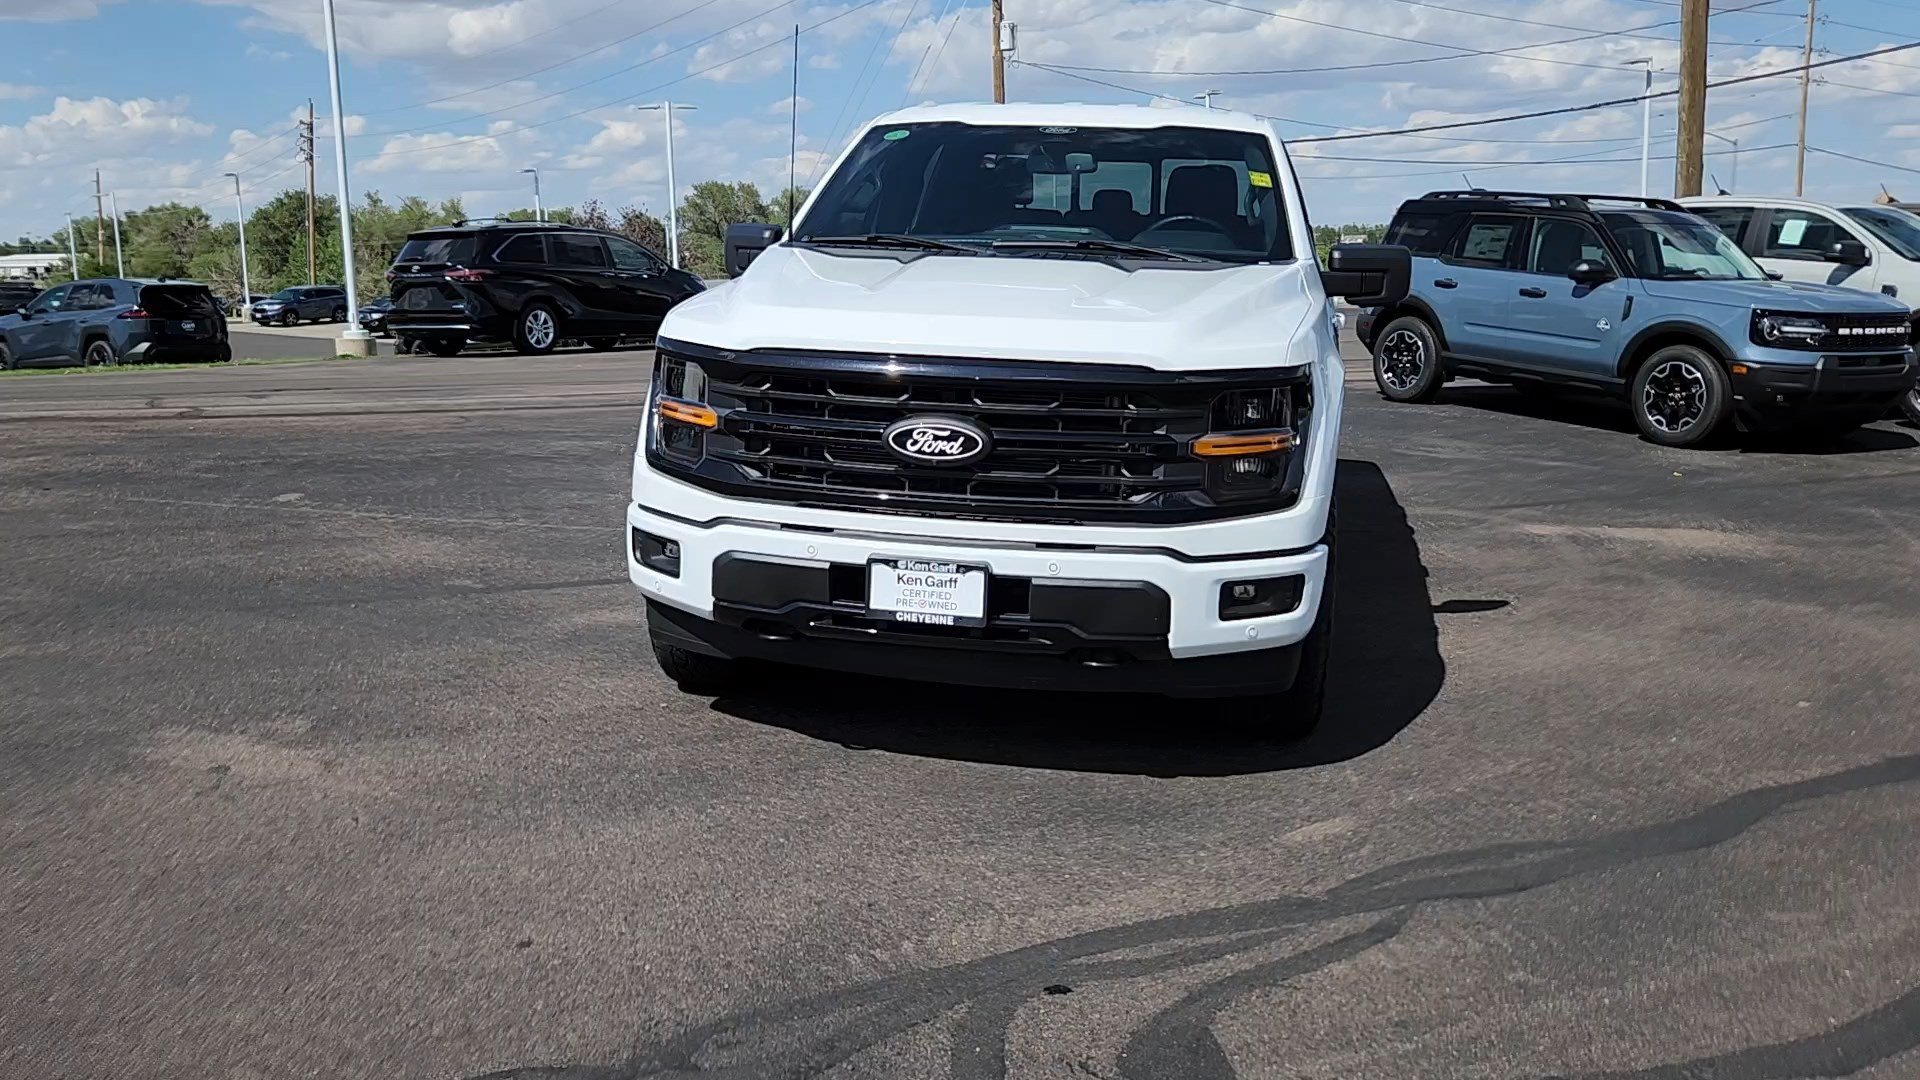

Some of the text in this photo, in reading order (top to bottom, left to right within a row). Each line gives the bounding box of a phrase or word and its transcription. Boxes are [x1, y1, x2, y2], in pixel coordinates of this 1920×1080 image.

[1837, 326, 1906, 336] BRONCO
[906, 428, 965, 455] Ford
[908, 560, 958, 574] Ken Garff
[897, 573, 959, 589] Ken Garff
[902, 588, 952, 601] CERTIFIED
[895, 612, 955, 626] CHEYENNE
